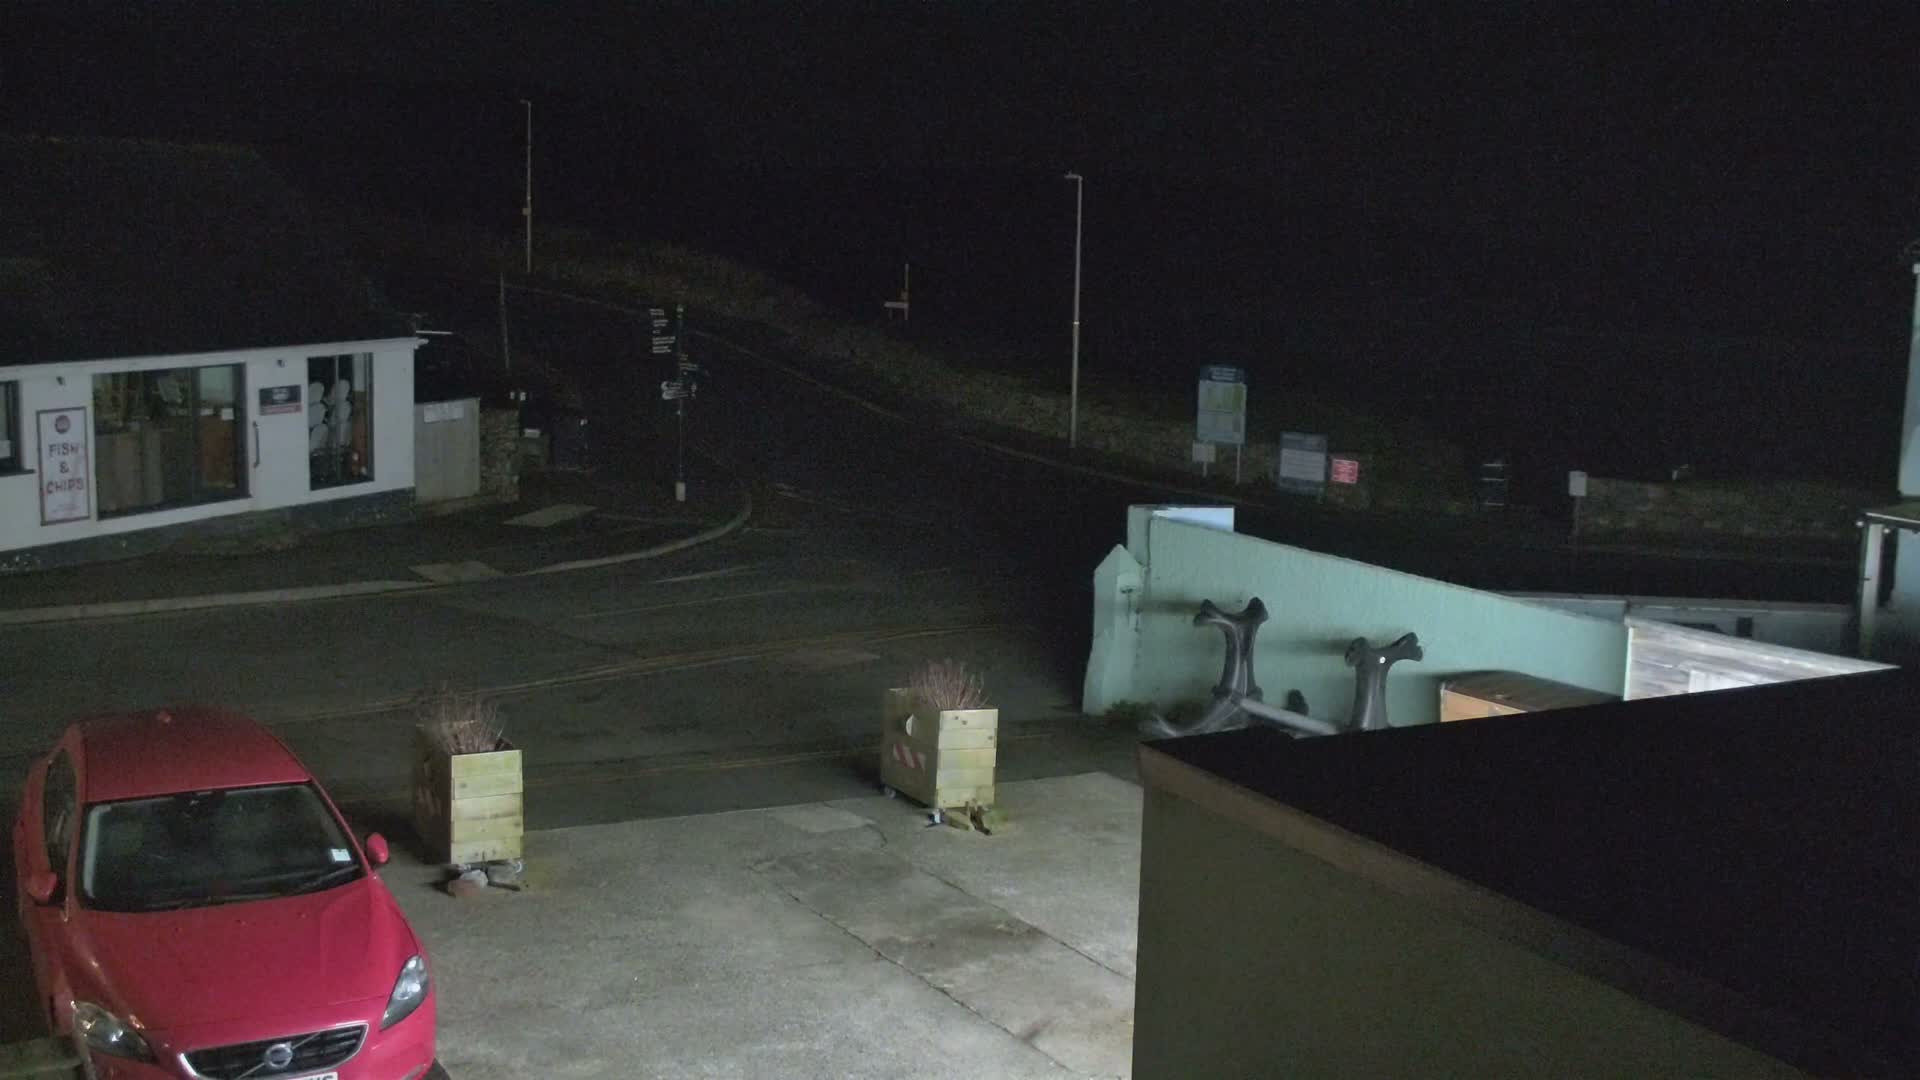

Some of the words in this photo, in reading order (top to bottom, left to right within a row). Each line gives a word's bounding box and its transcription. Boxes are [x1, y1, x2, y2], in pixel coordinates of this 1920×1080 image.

[49, 443, 79, 457] FISH
[59, 461, 69, 474] &
[46, 478, 84, 494] CHIPS
